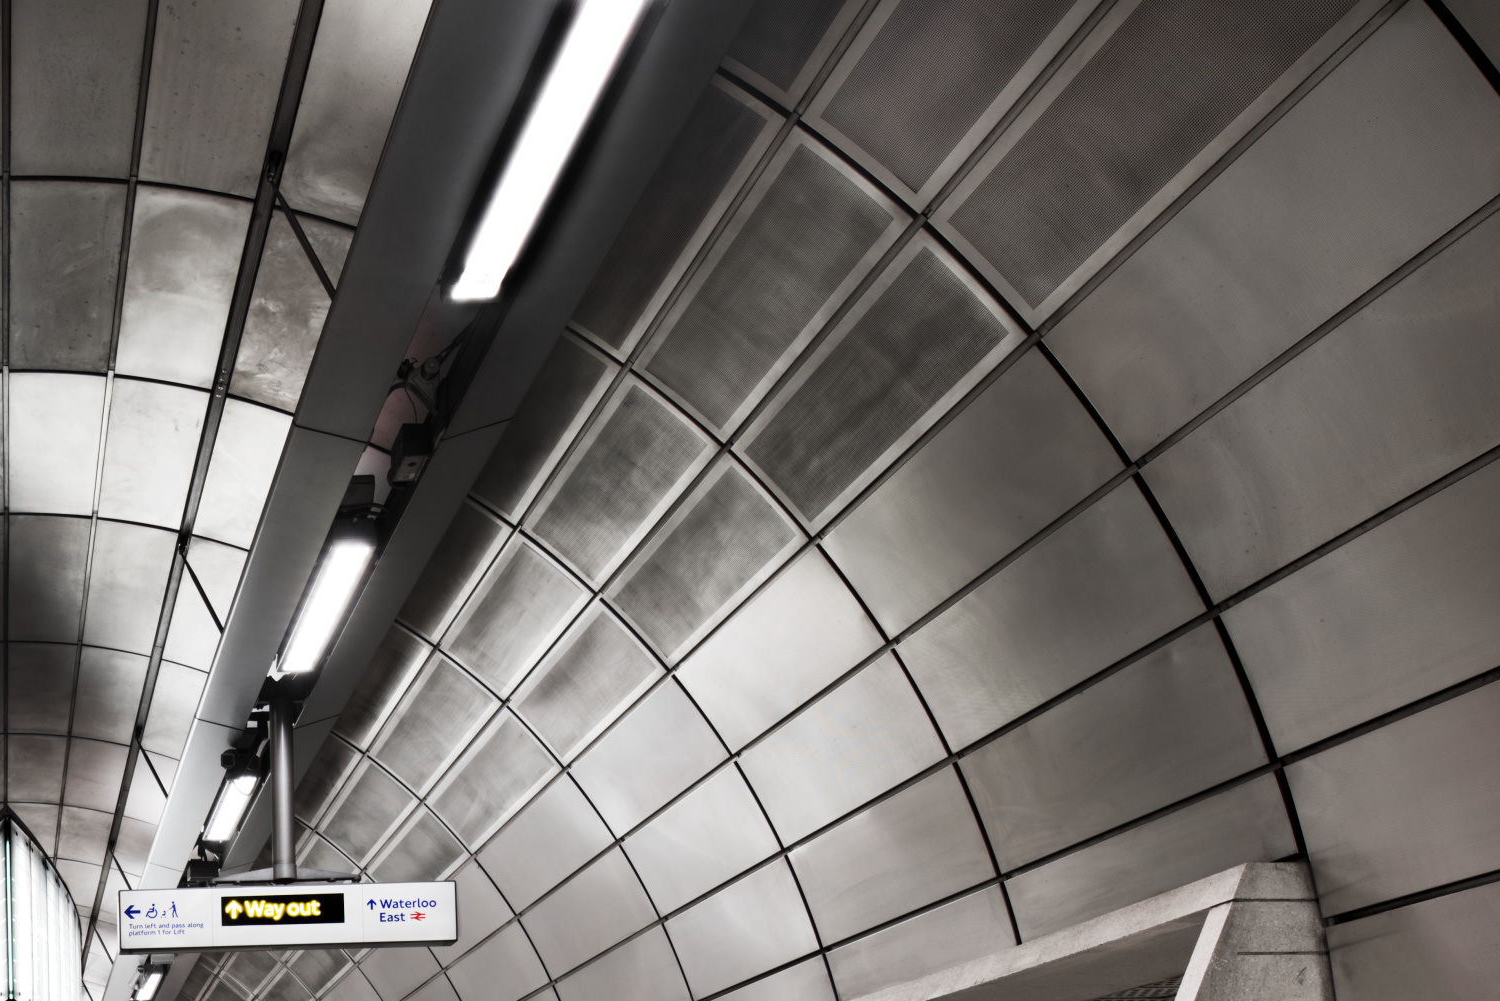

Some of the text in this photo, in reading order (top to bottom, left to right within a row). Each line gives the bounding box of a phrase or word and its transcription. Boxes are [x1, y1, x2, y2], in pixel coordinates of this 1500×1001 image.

[380, 898, 437, 909] Waterloo
[244, 899, 322, 921] Way out
[379, 912, 406, 922] East
